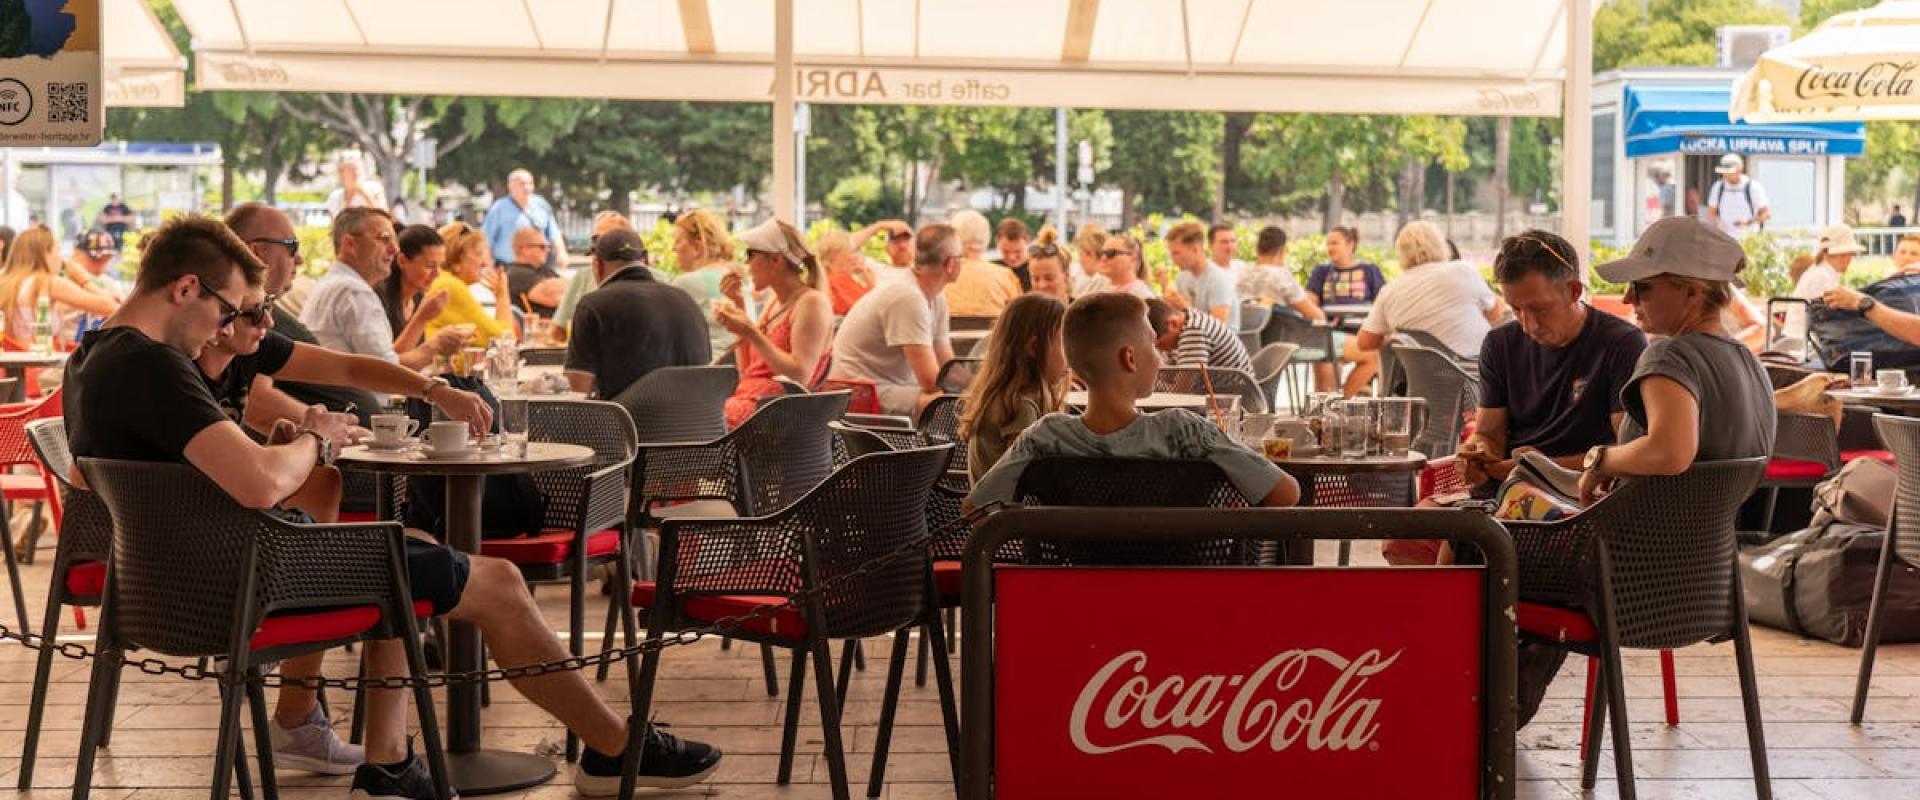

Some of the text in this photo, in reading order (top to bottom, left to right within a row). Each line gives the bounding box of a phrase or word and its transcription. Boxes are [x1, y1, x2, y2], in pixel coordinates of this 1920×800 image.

[1796, 62, 1919, 99] Coca-Cola
[1730, 138, 1784, 152] UPRAVA
[1788, 139, 1828, 153] SPLIT
[1070, 648, 1405, 754] Coca-Cola
